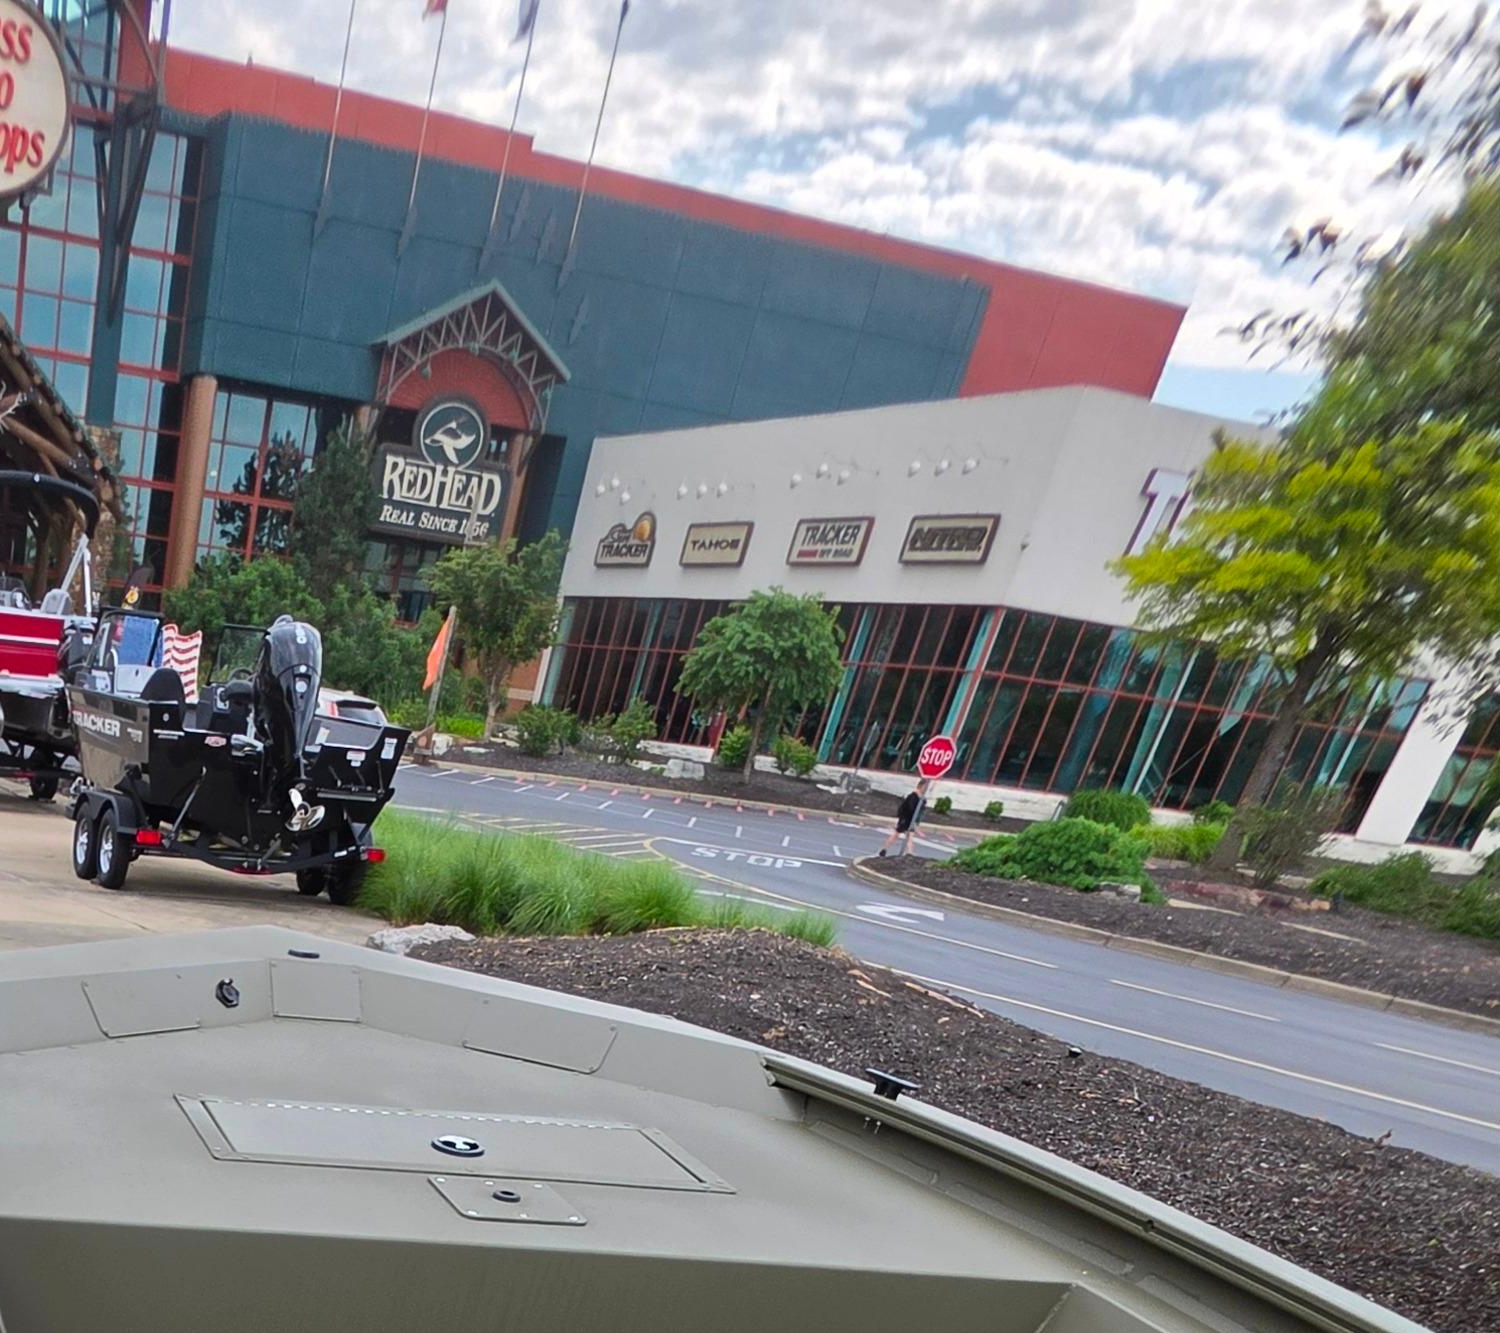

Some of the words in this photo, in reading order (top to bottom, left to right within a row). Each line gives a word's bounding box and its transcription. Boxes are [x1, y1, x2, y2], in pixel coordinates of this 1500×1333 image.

[690, 538, 741, 551] TAHOE
[800, 523, 862, 546] TRACKER
[600, 543, 649, 558] TRACKER
[71, 710, 121, 737] TRACKER
[920, 747, 953, 767] STOP
[691, 846, 803, 869] STOP
